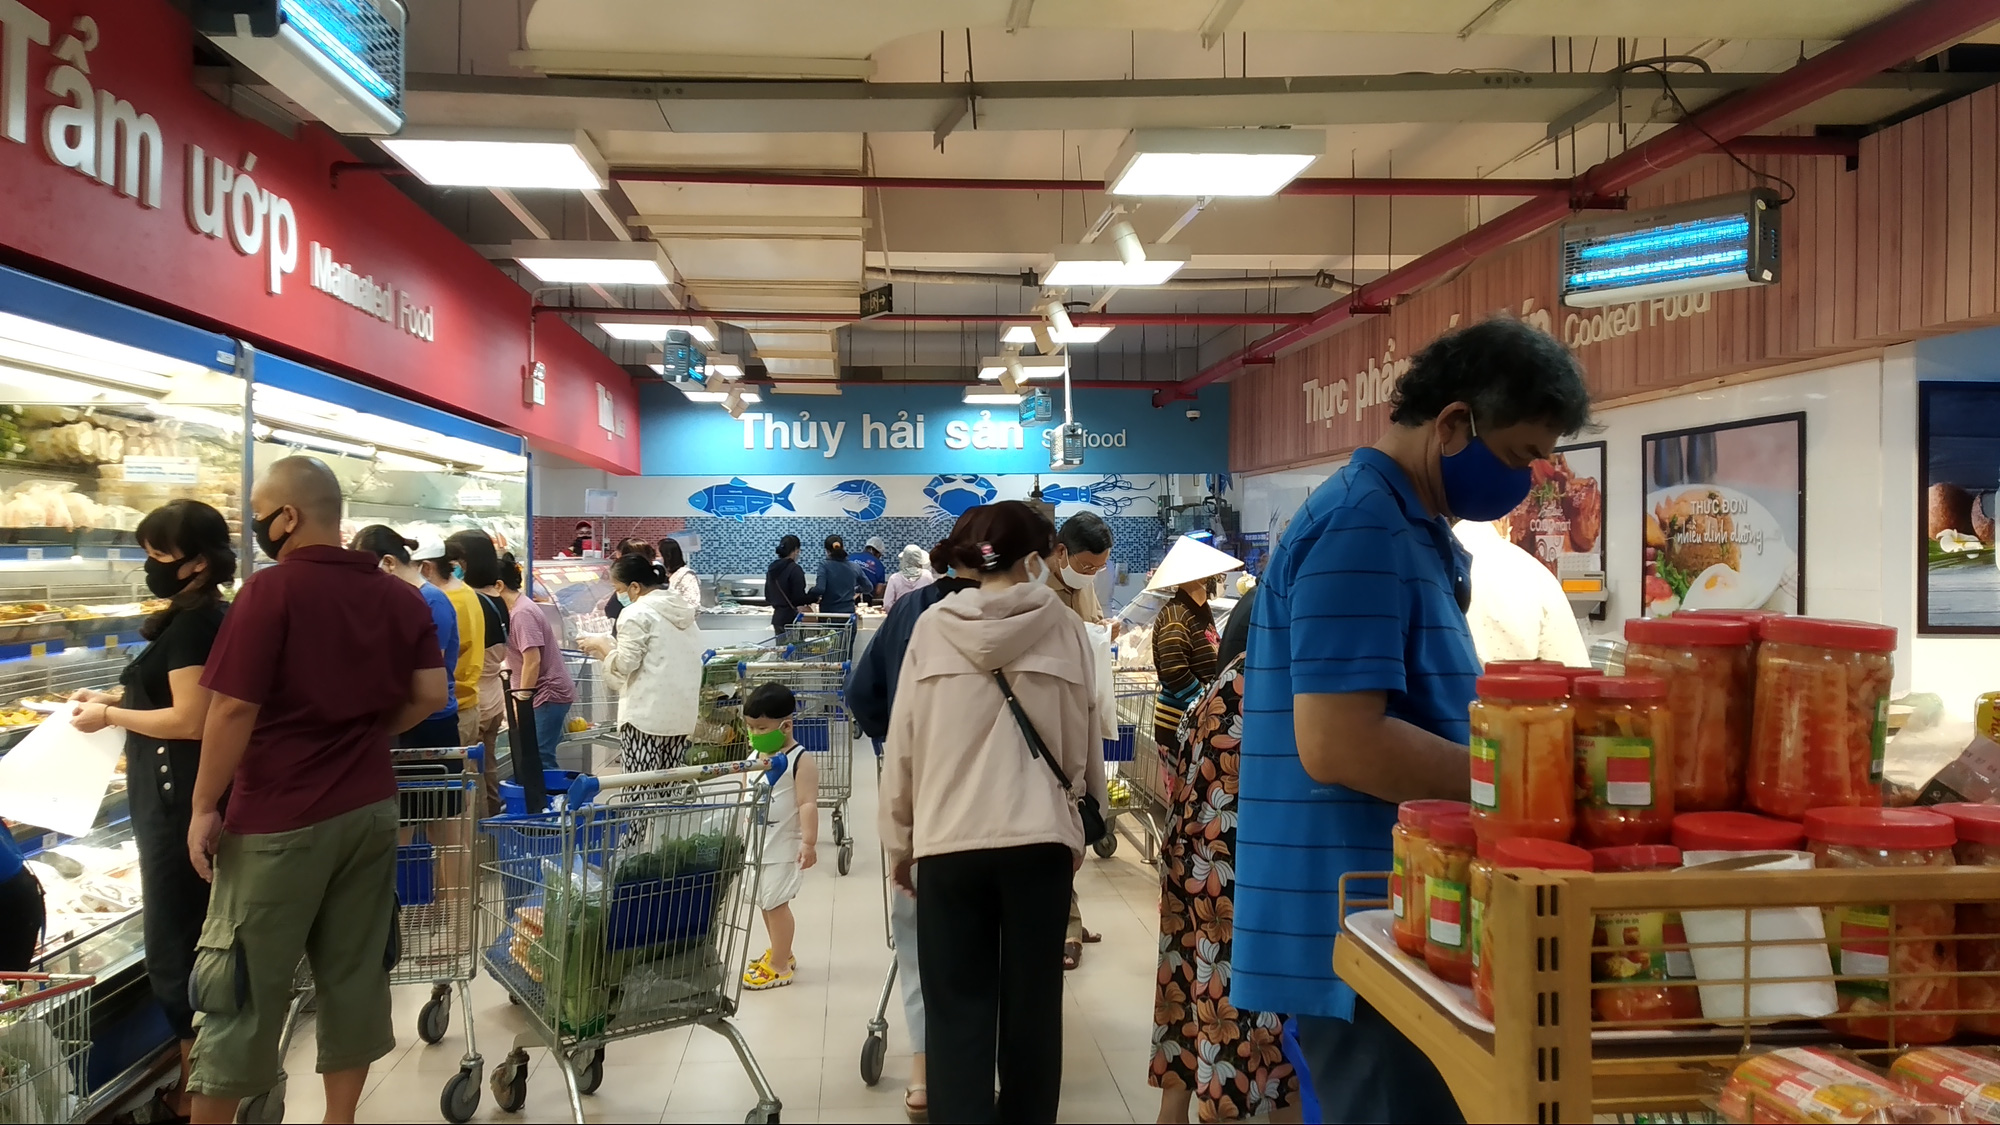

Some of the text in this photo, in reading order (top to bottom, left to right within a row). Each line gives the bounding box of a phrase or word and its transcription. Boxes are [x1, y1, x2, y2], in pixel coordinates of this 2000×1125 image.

[0, 0, 298, 295] Tẩm ướp
[310, 240, 435, 342] Marinated Food
[1565, 292, 1711, 349] Cooked Food
[1303, 377, 1349, 429] Thực
[737, 409, 1024, 459] Thủy hải sản
[1041, 428, 1127, 449] Sfood
